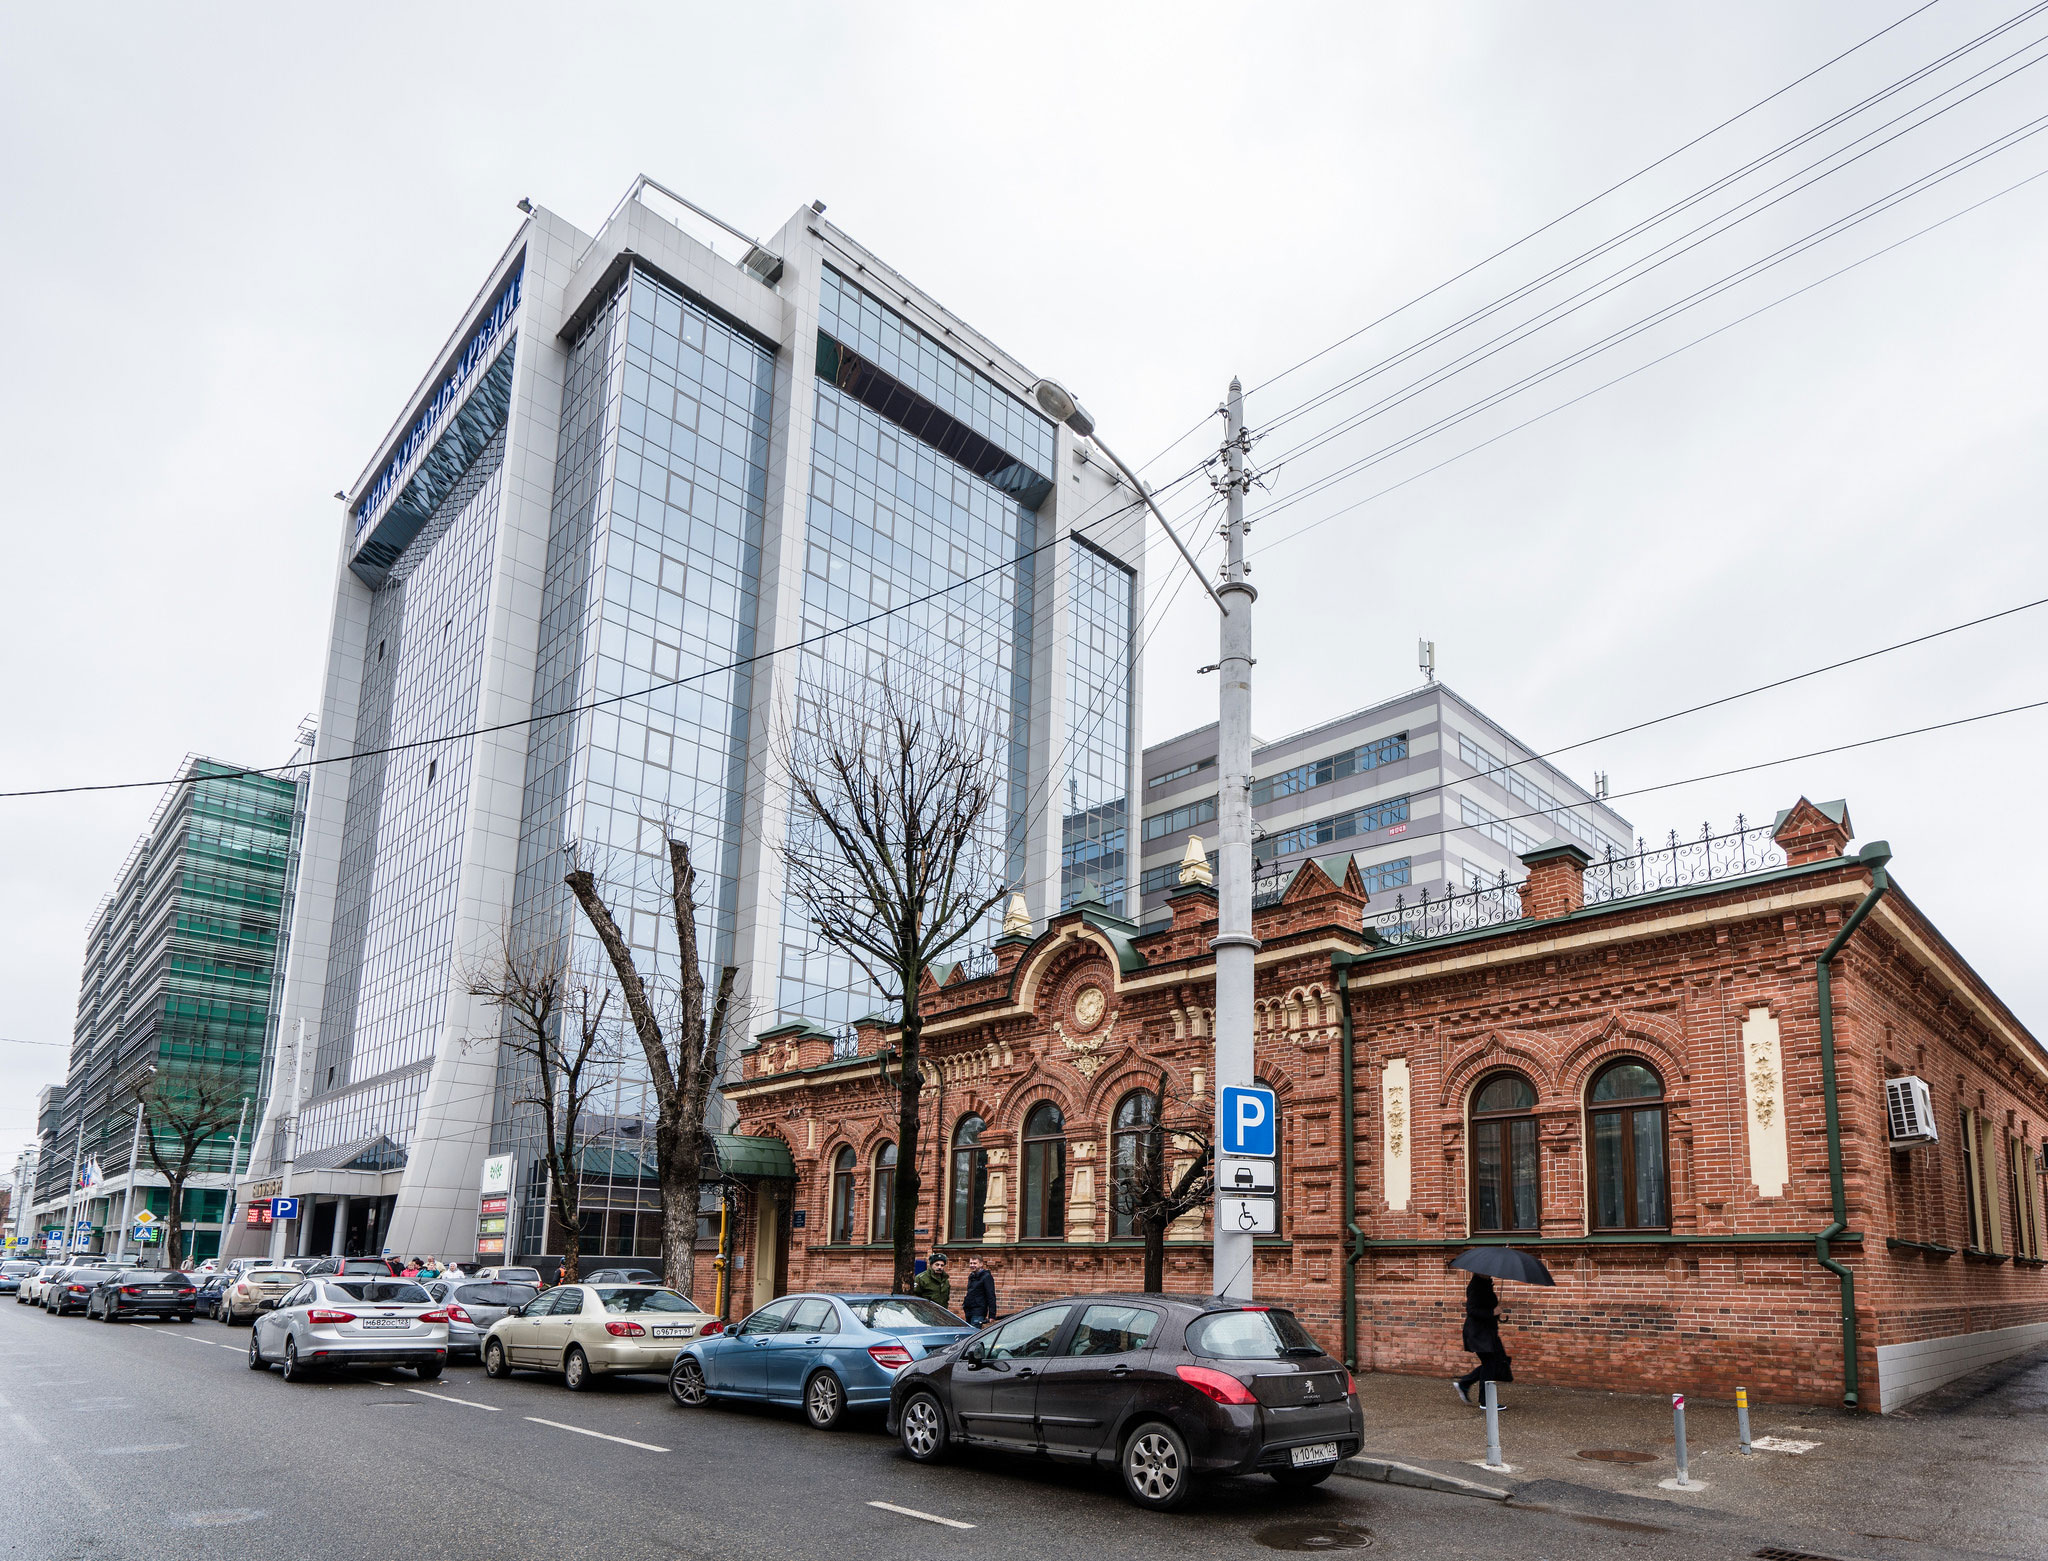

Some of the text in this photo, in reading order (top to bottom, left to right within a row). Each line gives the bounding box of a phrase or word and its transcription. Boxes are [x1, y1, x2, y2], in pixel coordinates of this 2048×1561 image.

[356, 268, 524, 537] БАНК КУБАНЬ КРЕДИ
[1236, 1094, 1266, 1147] P
[277, 1200, 292, 1216] P
[20, 1237, 28, 1245] P
[52, 1231, 61, 1240] P
